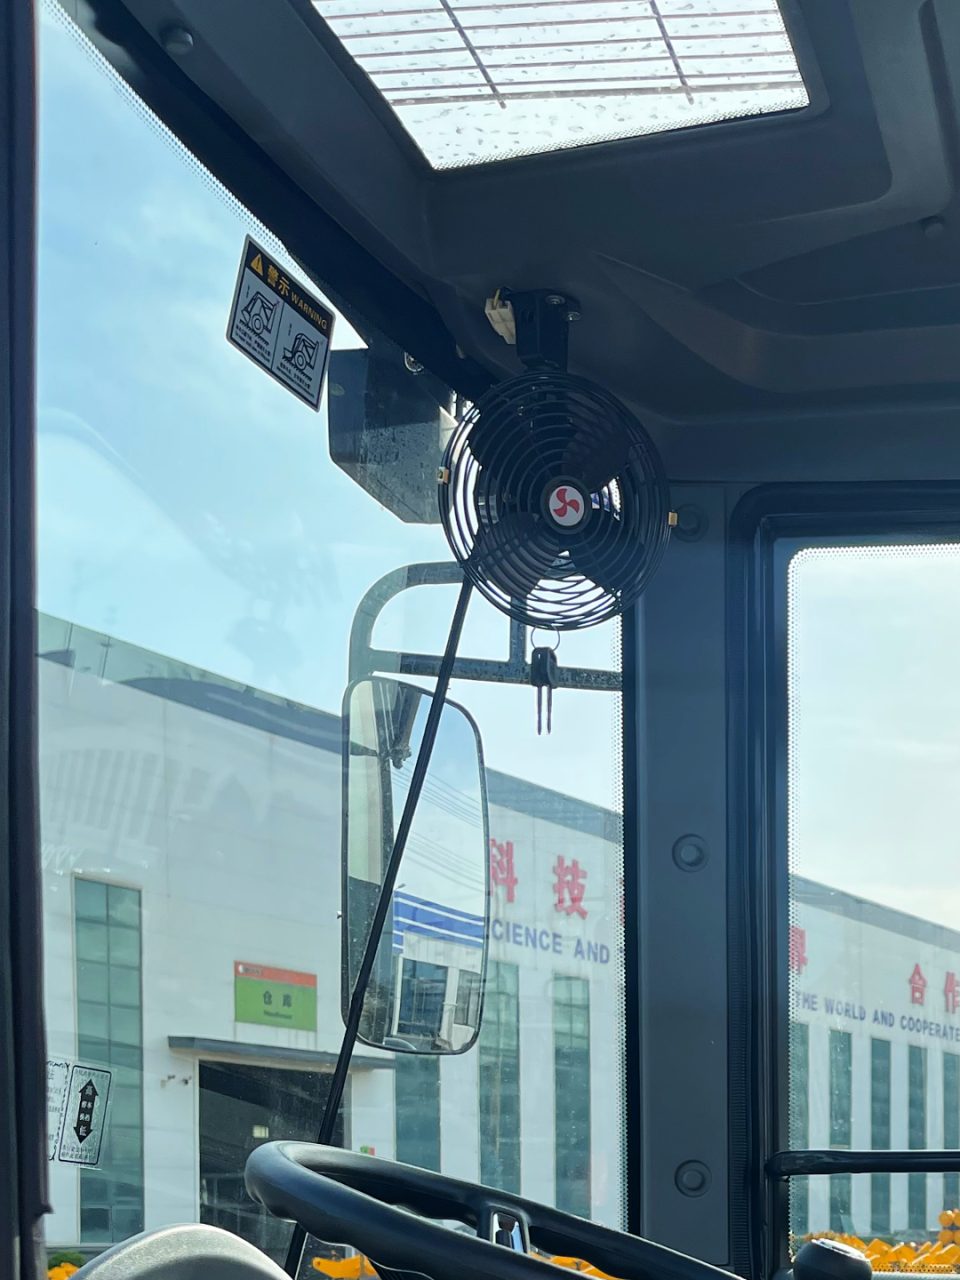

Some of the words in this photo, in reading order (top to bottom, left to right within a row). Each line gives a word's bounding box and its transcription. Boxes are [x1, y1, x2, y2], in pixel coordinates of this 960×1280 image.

[267, 265, 290, 296] 警示
[291, 291, 328, 330] WARNING
[491, 920, 562, 954] CIENCE
[574, 938, 610, 964] AND
[824, 996, 867, 1021] WORLD
[873, 1009, 895, 1028] AND
[900, 1014, 960, 1043] COOPERATE
